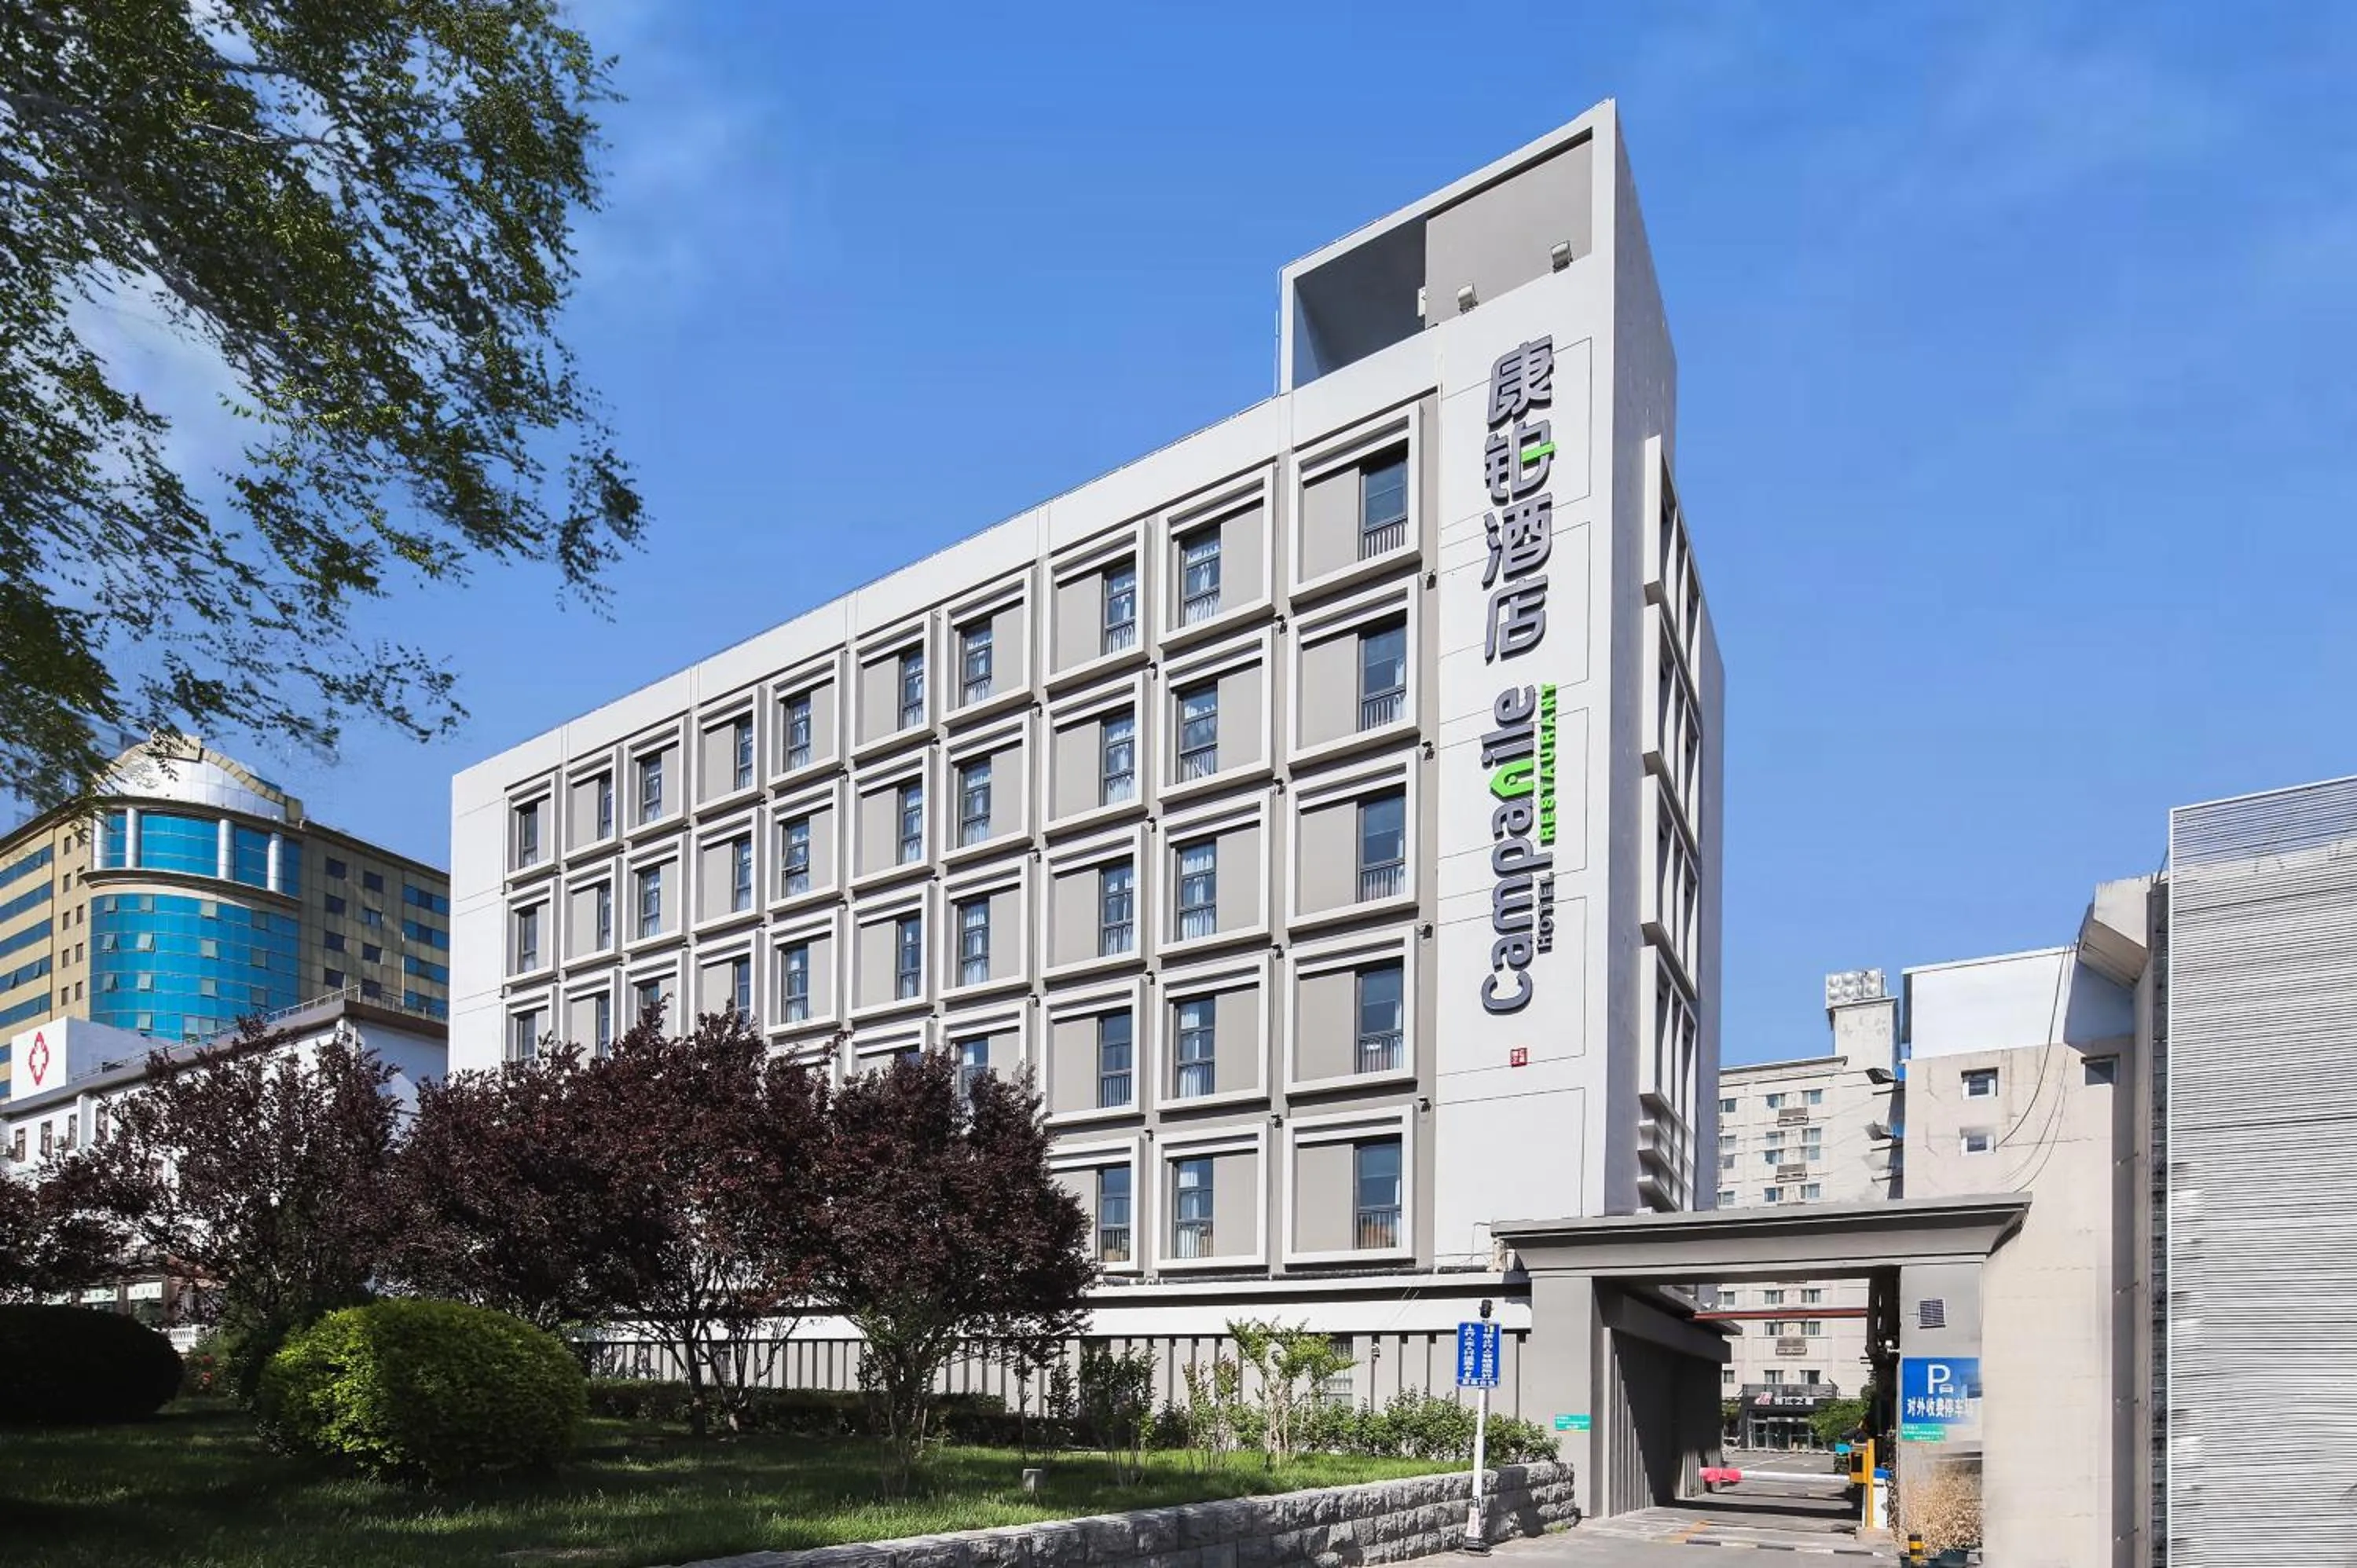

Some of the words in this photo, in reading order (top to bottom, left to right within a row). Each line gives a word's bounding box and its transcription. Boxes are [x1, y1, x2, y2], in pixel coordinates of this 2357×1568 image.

[1483, 334, 1556, 665] 康铂酒店
[1539, 681, 1557, 847] RESTAURANT
[1481, 684, 1553, 1016] Campanile
[1538, 871, 1555, 955] HOTEL
[1927, 1364, 1951, 1394] P
